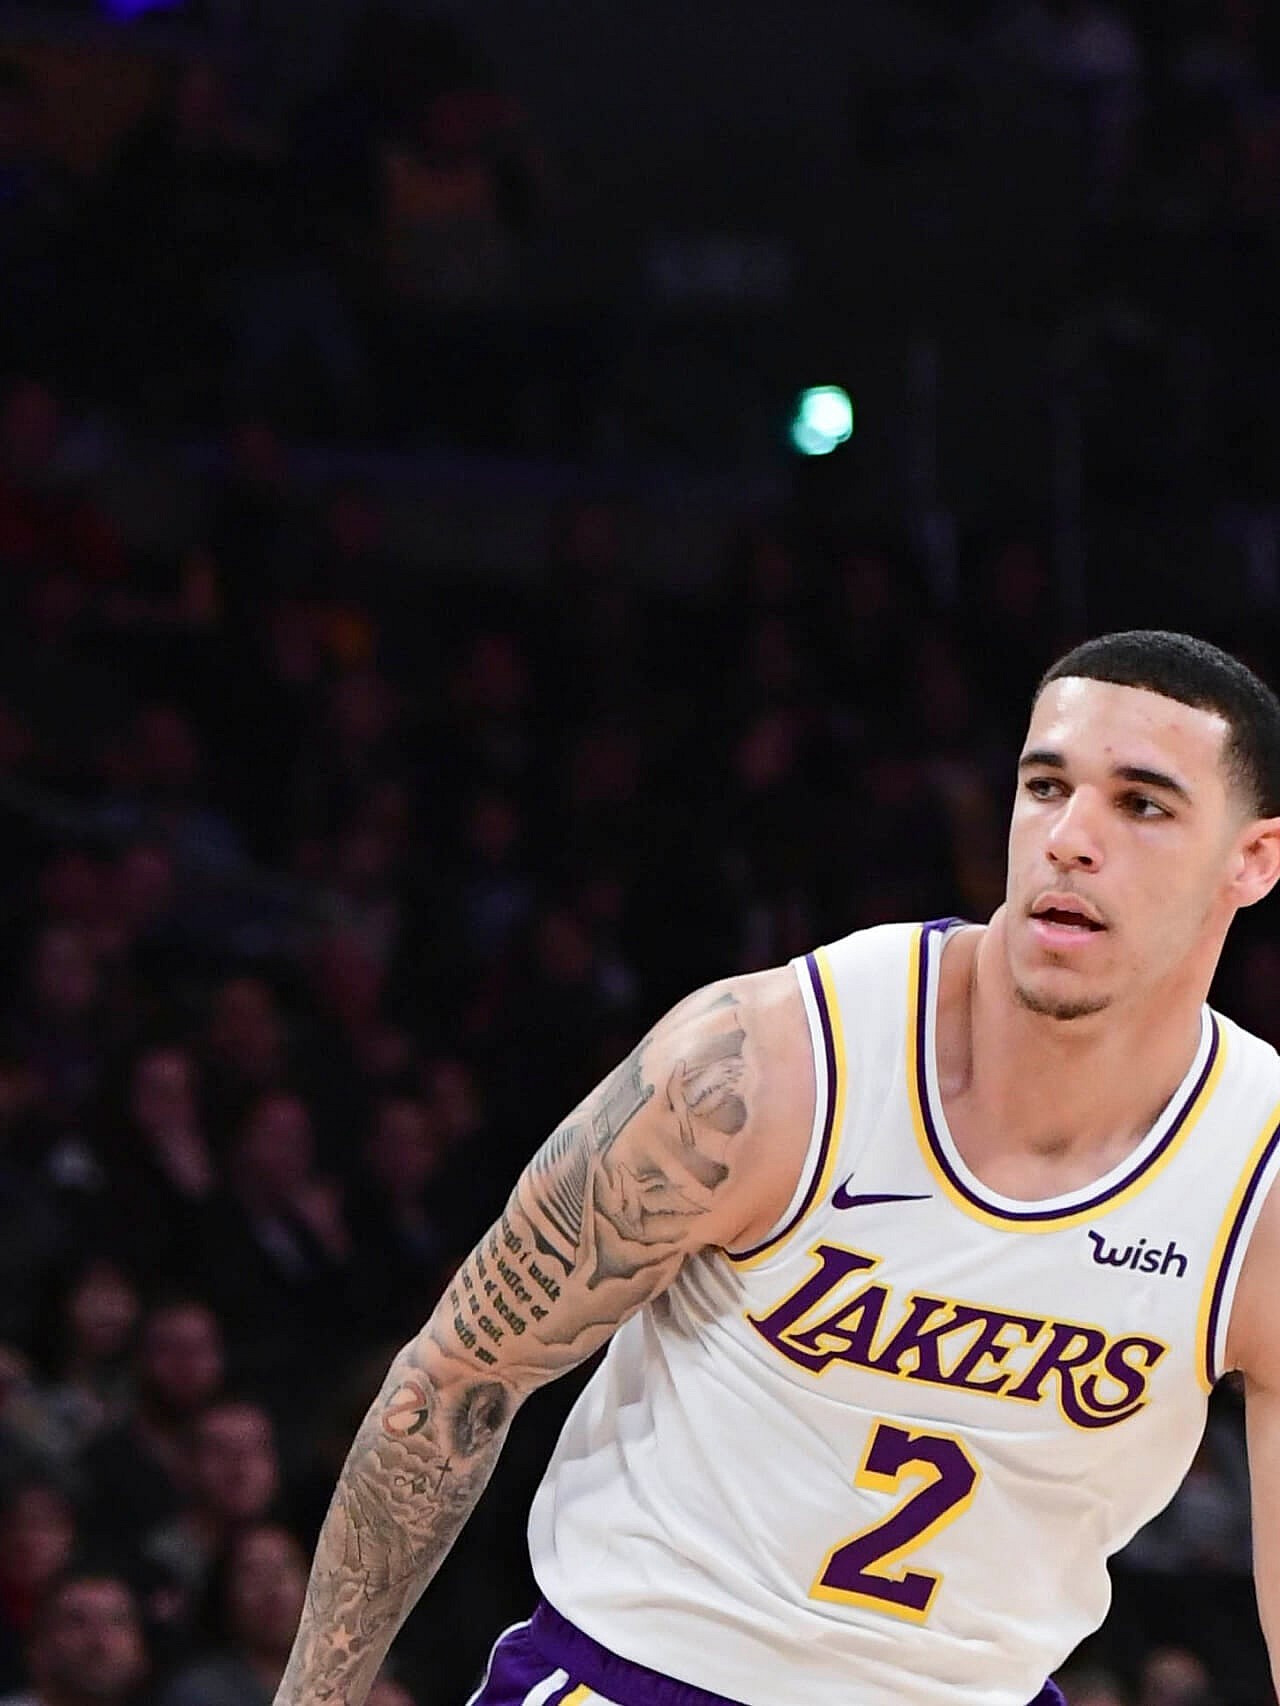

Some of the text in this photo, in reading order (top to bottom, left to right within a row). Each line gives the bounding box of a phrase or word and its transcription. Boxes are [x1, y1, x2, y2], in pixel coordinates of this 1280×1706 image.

[744, 1238, 1171, 1433] LAKERS
[1088, 1230, 1187, 1277] wish
[809, 1418, 984, 1624] 2
